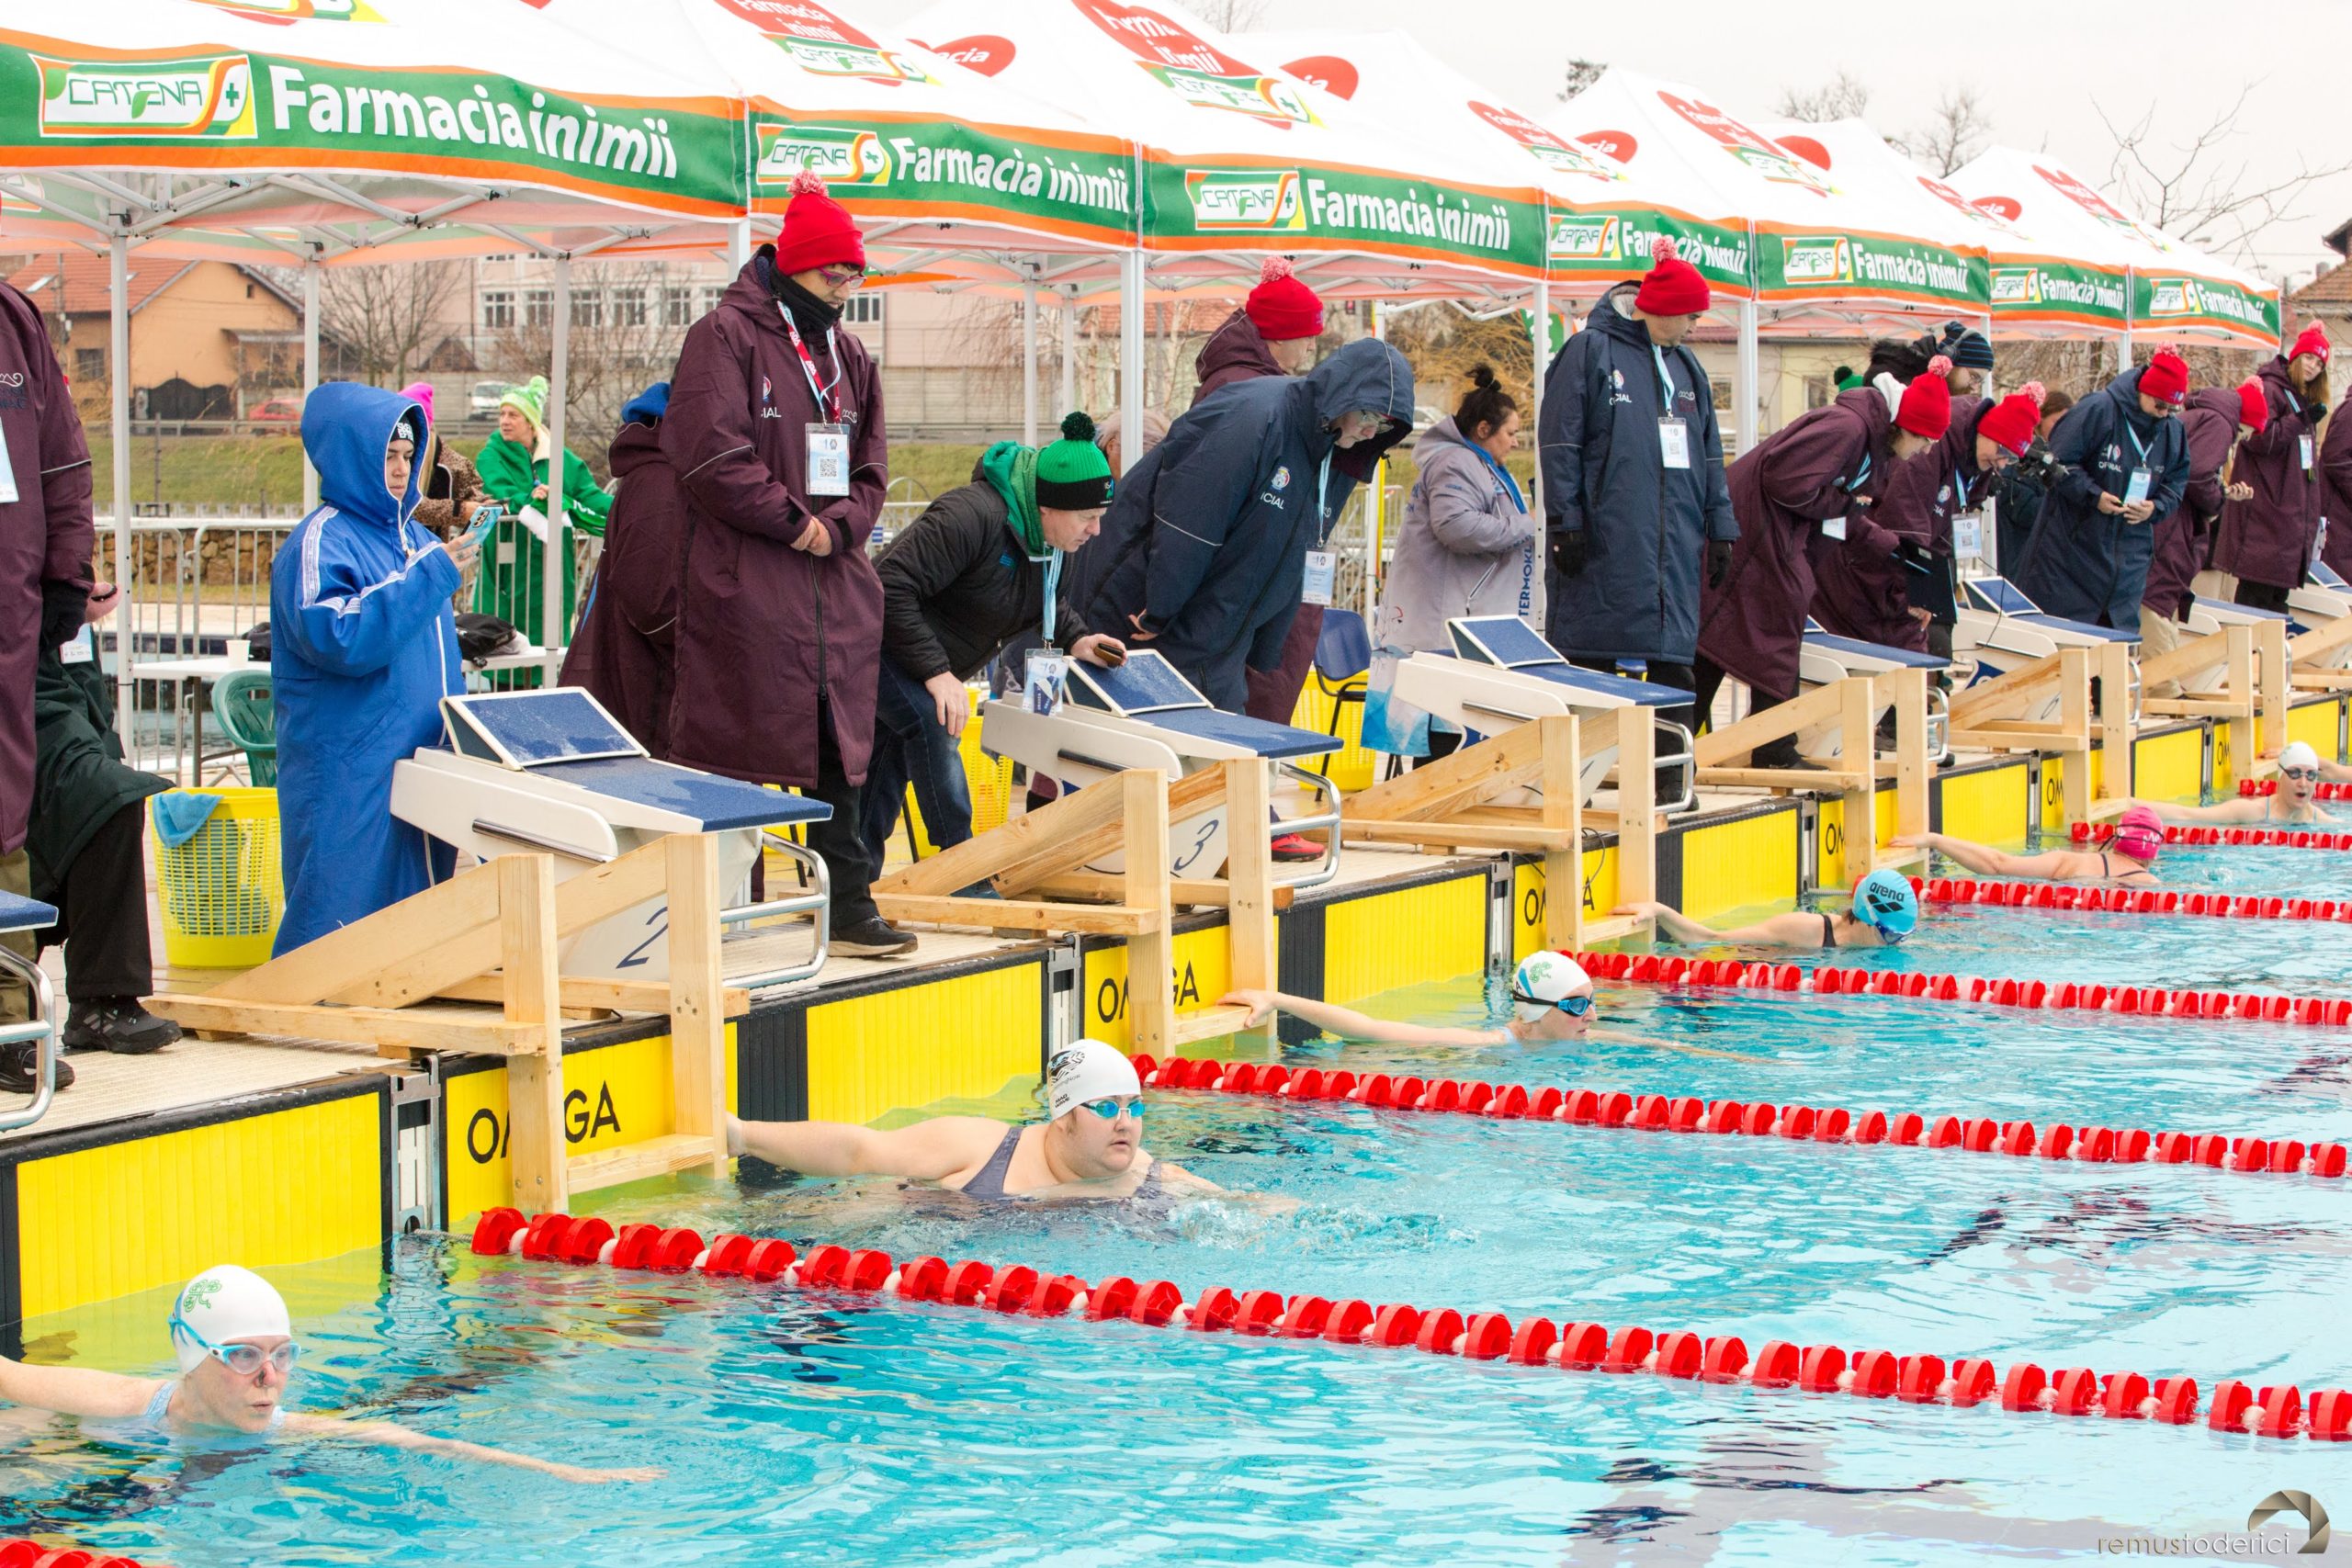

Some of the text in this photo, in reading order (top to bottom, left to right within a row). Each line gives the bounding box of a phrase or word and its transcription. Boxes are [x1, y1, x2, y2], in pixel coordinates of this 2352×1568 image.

[67, 78, 204, 110] CATENA
[268, 64, 679, 180] Farmacia inimii
[771, 142, 850, 167] CATENA
[888, 137, 1130, 214] Farmacia inimii
[1201, 189, 1275, 211] CATENA
[1307, 178, 1511, 252] Farmacia inimii
[1557, 229, 1600, 243] CATENA
[1792, 252, 1833, 269] CATENA
[1851, 243, 1969, 294] Farmacia inimii
[2040, 272, 2096, 305] Farmacia
[1518, 545, 1533, 617] TERMOKL
[1174, 819, 1219, 871] 3
[1869, 882, 1905, 903] arena
[616, 906, 669, 969] 2
[467, 1080, 622, 1165] OGA
